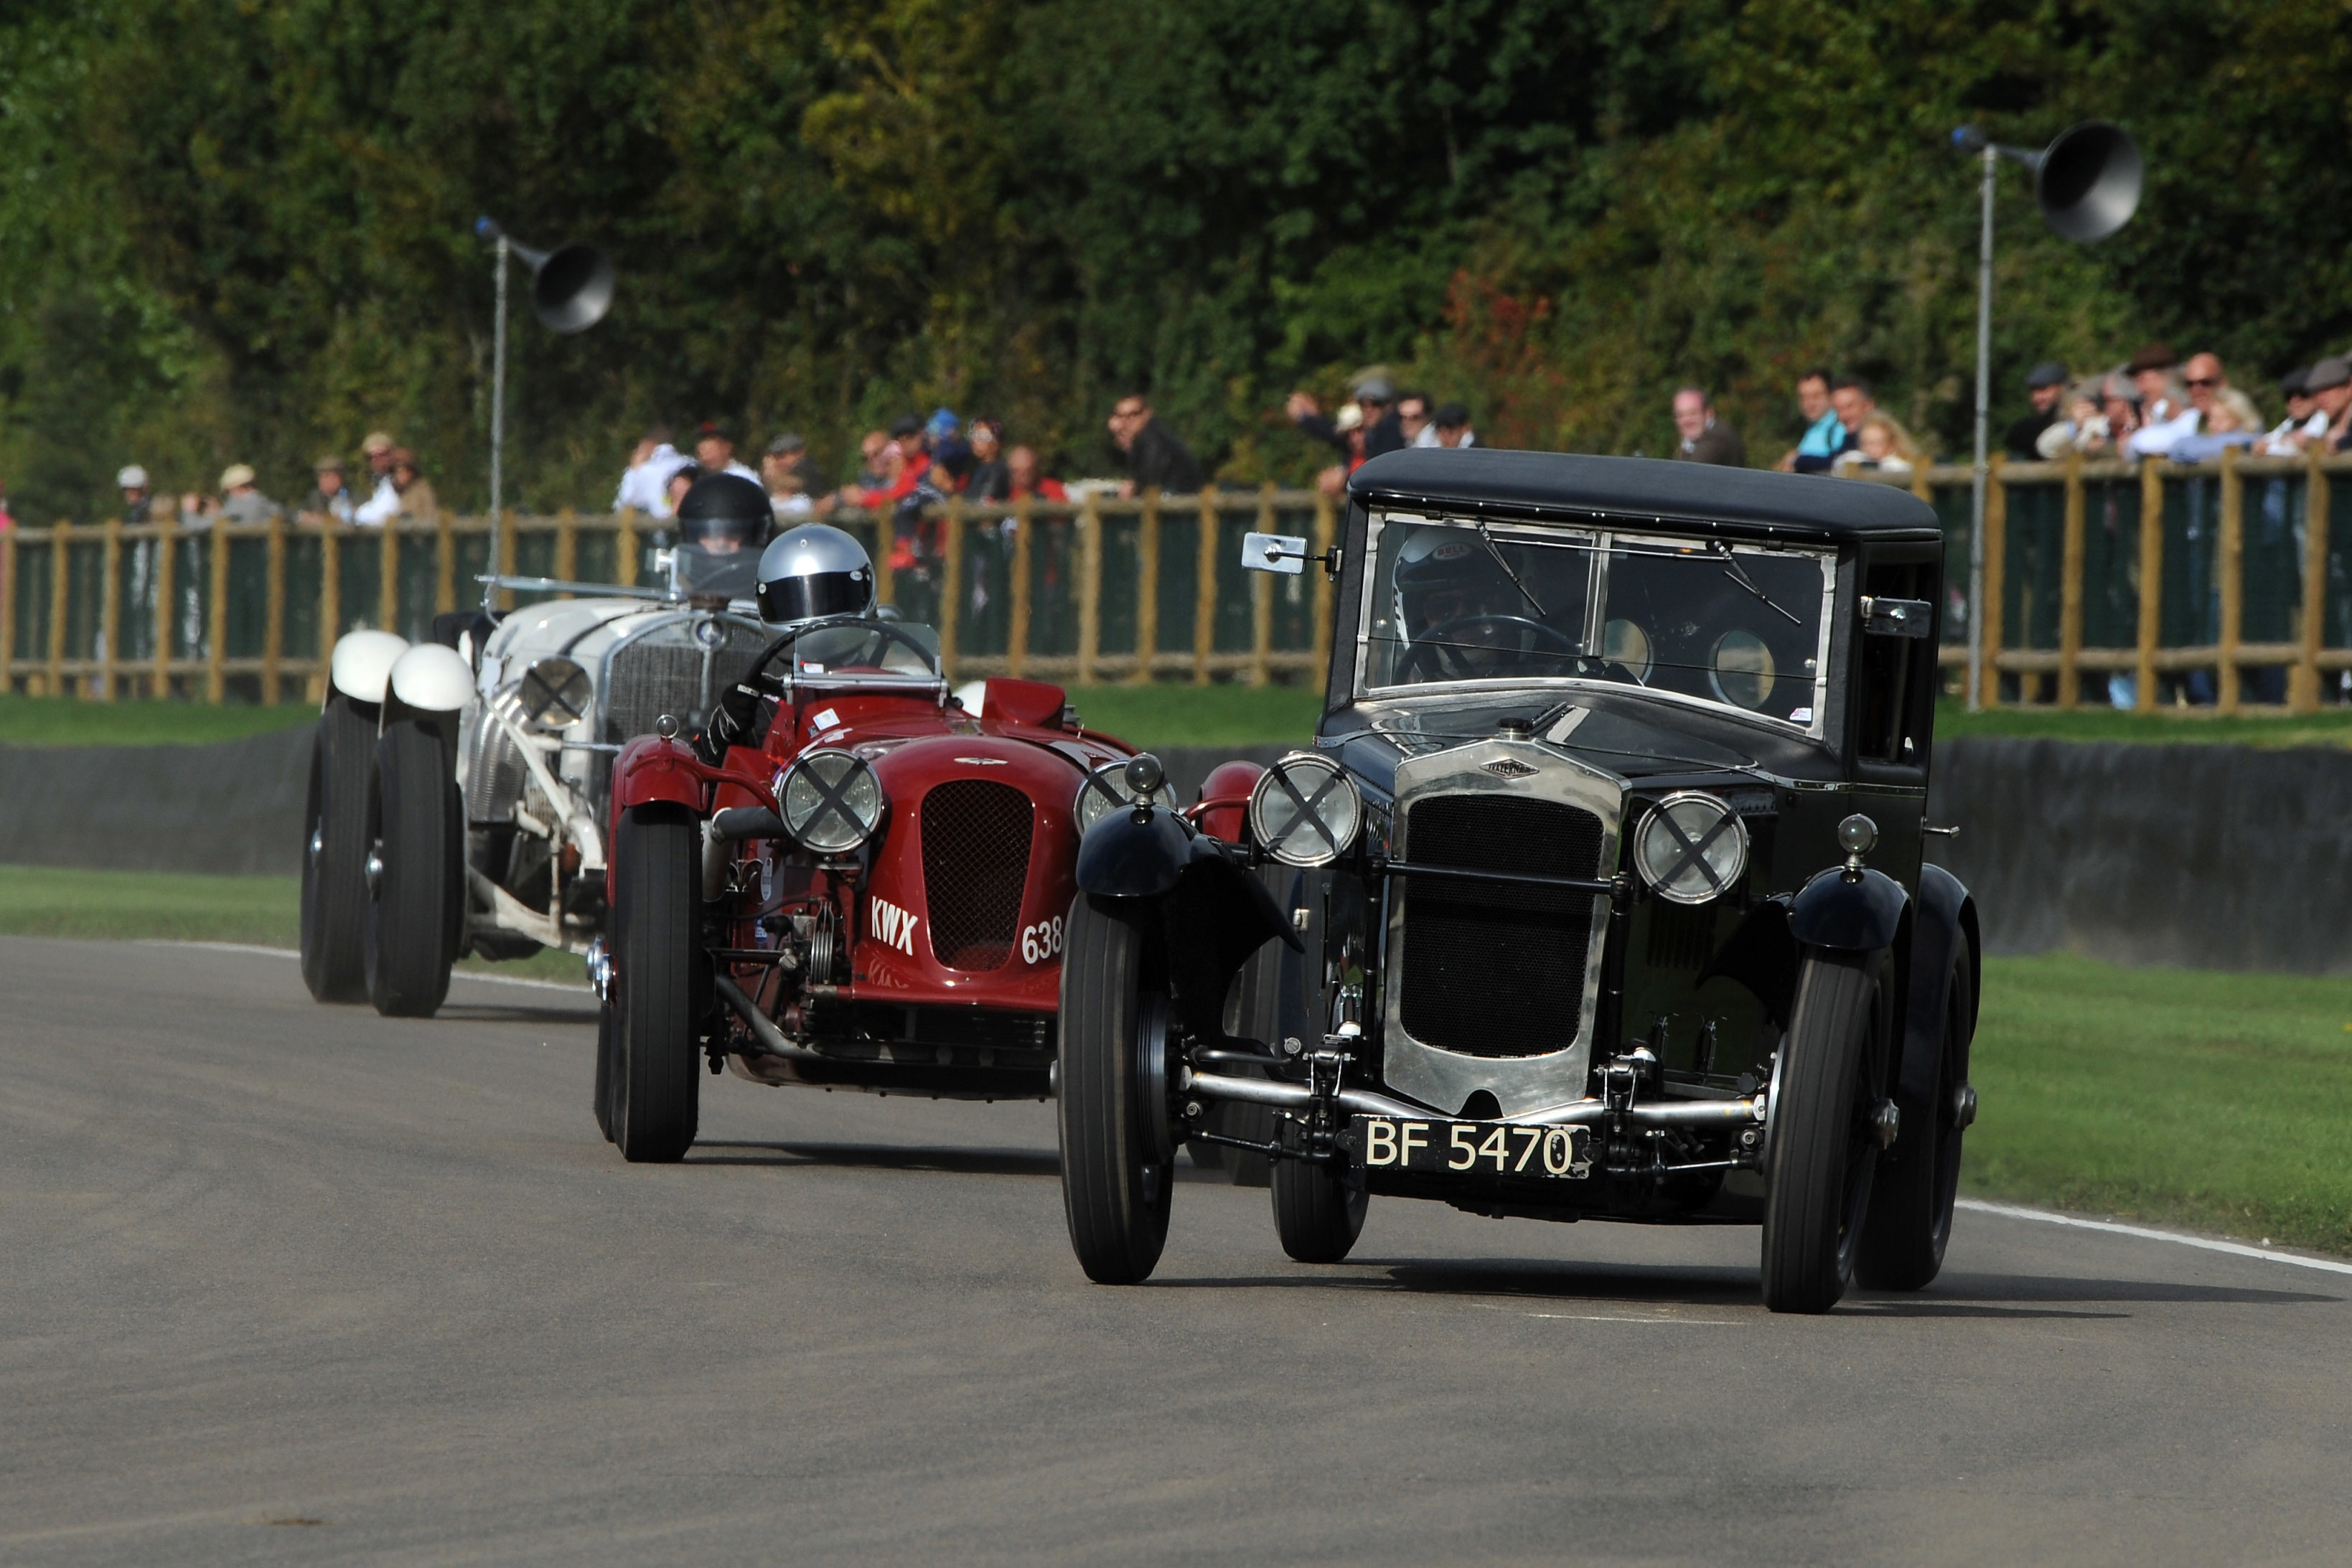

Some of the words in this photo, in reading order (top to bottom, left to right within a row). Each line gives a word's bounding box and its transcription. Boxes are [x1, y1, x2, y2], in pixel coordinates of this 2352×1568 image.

[872, 896, 918, 956] KWX
[1022, 916, 1062, 964] 638
[1367, 1121, 1429, 1166] BF
[1448, 1125, 1573, 1174] 5470
